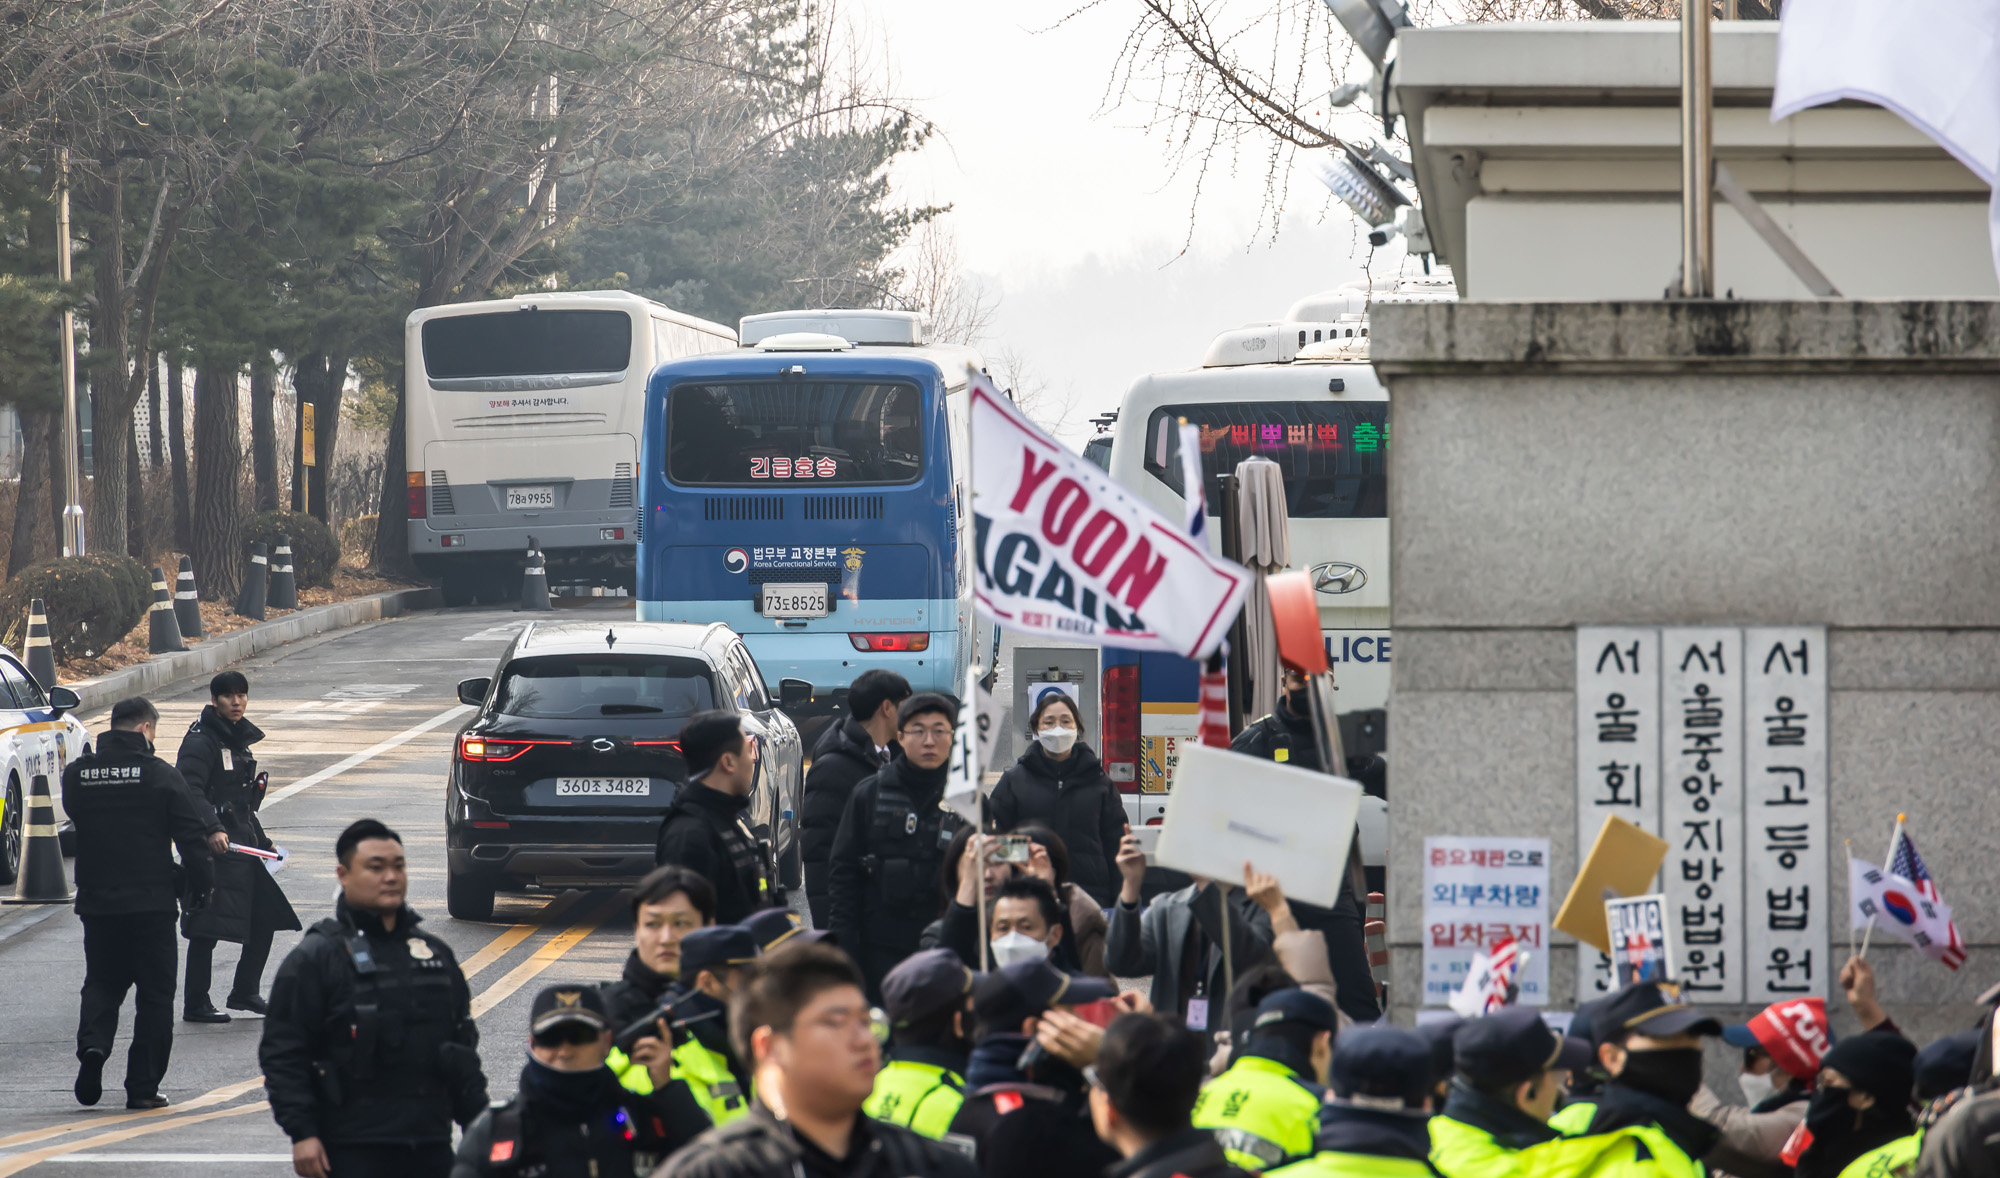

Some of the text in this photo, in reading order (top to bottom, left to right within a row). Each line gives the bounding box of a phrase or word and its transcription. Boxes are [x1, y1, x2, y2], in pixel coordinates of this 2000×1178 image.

[484, 376, 571, 390] DAEWOO
[489, 400, 510, 408] 양보해
[532, 397, 568, 406] 감사합니다.
[750, 457, 836, 478] 긴급호송
[509, 493, 552, 504] 78라9955
[1009, 444, 1168, 614] YOON
[753, 547, 837, 560] 법무부 교정본부
[753, 560, 773, 568] Korea
[773, 560, 813, 568] Correctional
[766, 596, 825, 611] 73도8525
[1324, 636, 1391, 663] LICE
[25, 753, 41, 779] POLICE
[80, 766, 141, 779] 대한민국법원
[562, 779, 644, 794] 360조 3482
[1680, 640, 1726, 992] 서울중앙지방법원
[1764, 639, 1812, 993] 서울고등법원
[1432, 883, 1541, 908] 외부차량
[1430, 922, 1541, 949] 입차금지
